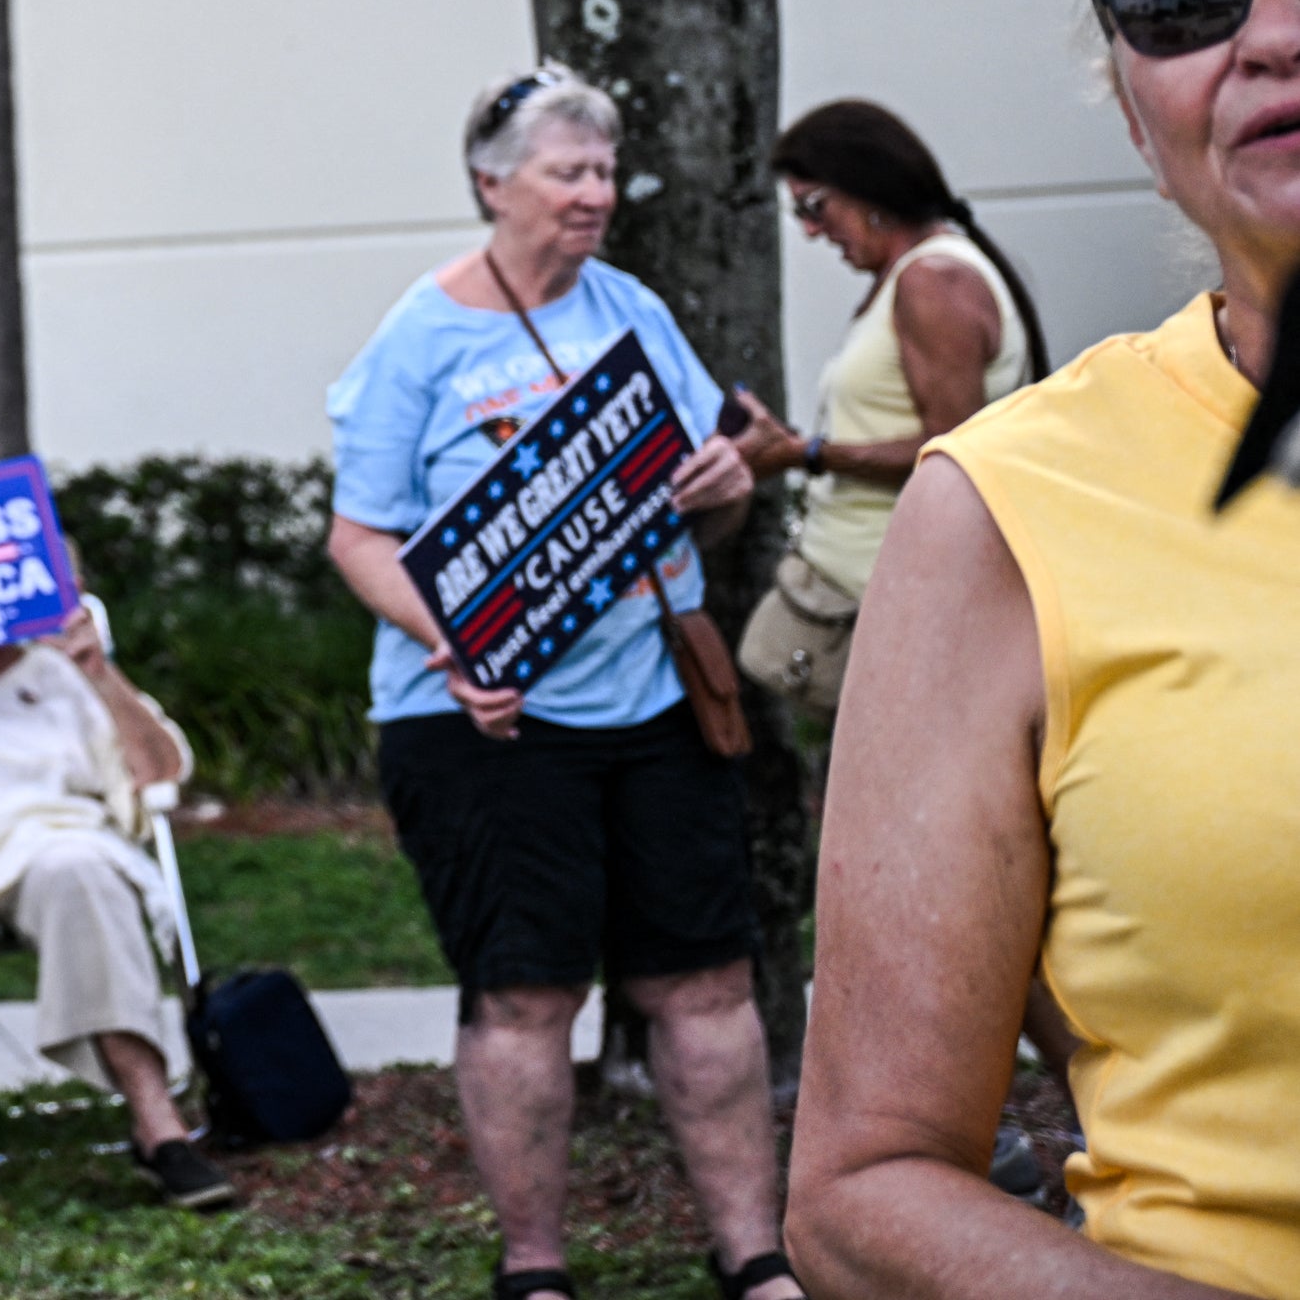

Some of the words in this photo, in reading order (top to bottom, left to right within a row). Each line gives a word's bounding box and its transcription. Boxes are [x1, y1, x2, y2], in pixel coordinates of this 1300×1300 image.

[435, 540, 490, 619] ARE
[475, 501, 528, 568] WE
[516, 428, 598, 530] GREAT
[587, 369, 655, 456] YET?
[513, 478, 628, 591] 'CAUSE
